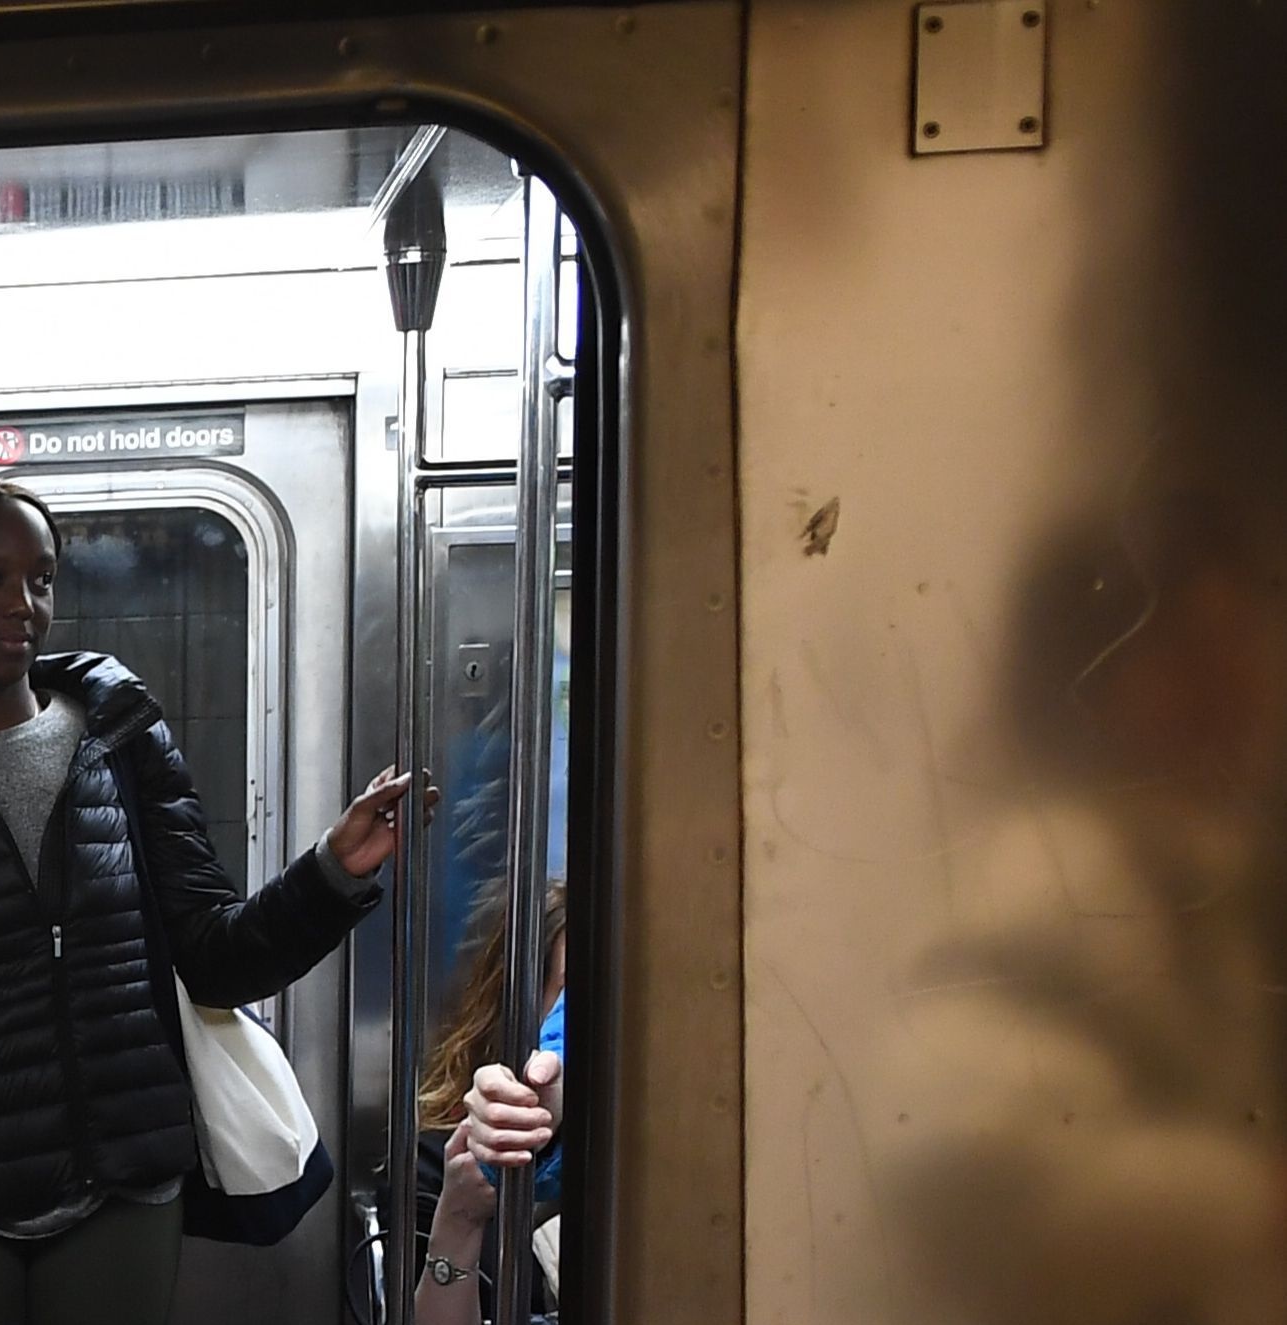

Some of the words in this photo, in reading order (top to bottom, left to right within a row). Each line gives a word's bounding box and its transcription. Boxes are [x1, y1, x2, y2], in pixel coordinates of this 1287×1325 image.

[29, 432, 62, 455] Do
[67, 430, 105, 453] not
[110, 427, 161, 450] hold
[165, 425, 234, 448] doors
